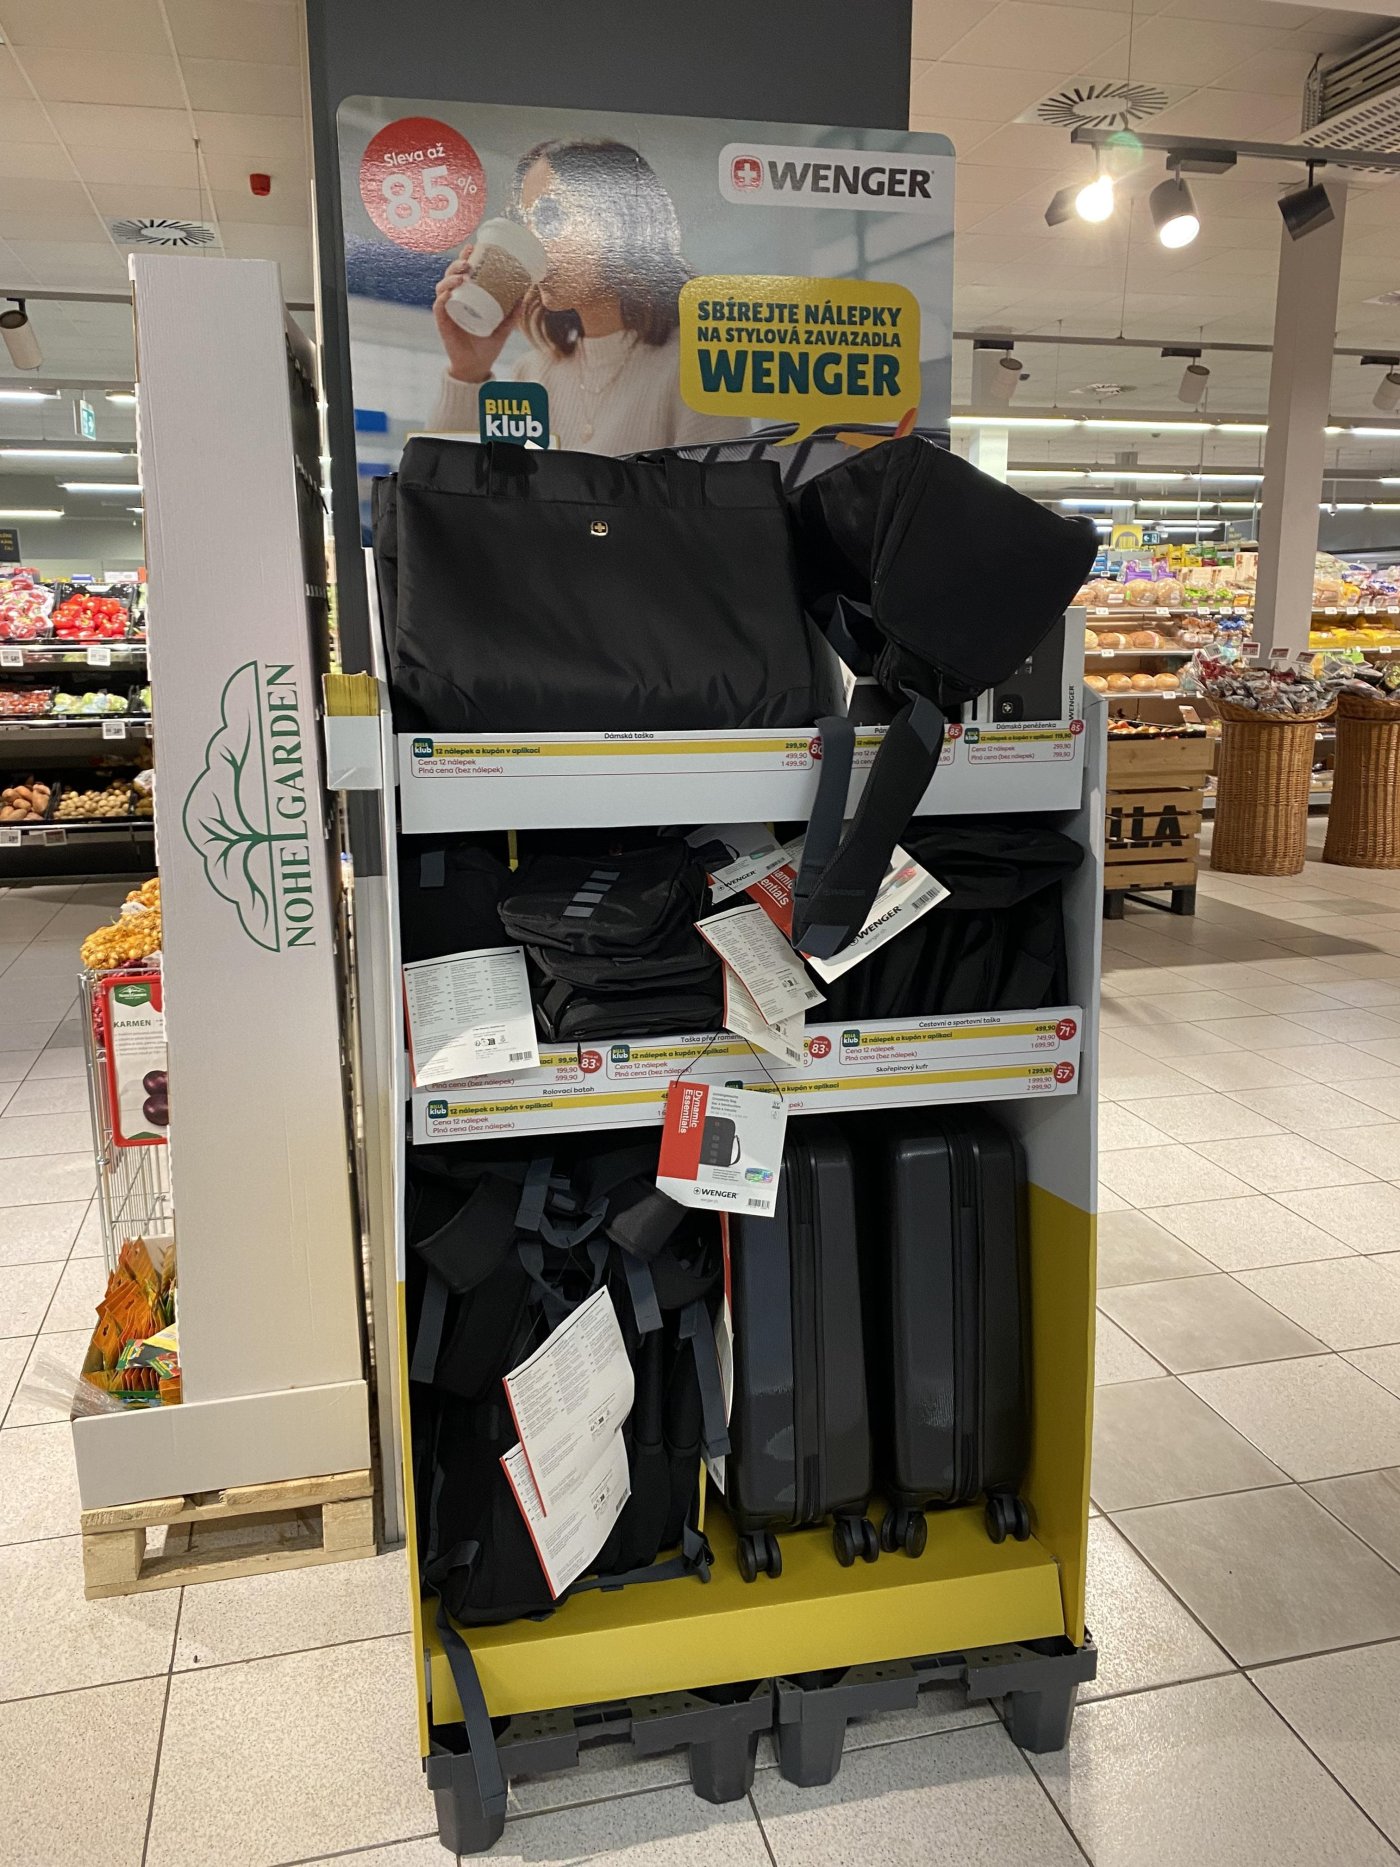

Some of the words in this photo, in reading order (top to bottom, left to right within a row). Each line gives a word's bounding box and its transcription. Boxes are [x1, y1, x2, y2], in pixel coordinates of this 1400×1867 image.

[383, 150, 424, 167] Sleva
[427, 142, 446, 160] až
[768, 160, 932, 199] WENGER
[697, 296, 799, 324] SBÍREJTE
[804, 299, 902, 328] NÁLEPKY
[697, 326, 722, 343] NA
[725, 326, 801, 345] STYLOVÁ
[804, 330, 902, 348] ZAVAZADLA
[697, 348, 902, 397] WENGER
[485, 398, 532, 415] BILLA
[485, 414, 543, 438] klub
[604, 731, 633, 740] Dámská
[634, 731, 655, 739] taška
[414, 746, 432, 754] klub
[785, 741, 808, 750] 299,90
[444, 747, 475, 756] nálepek
[481, 747, 505, 756] kupón
[785, 752, 808, 760] 499,90
[439, 758, 446, 766] 12
[447, 758, 477, 767] nálepek
[454, 766, 471, 775] (bez
[472, 765, 504, 774] nálepek)
[760, 878, 789, 906] entials
[856, 904, 903, 939] WENGER
[113, 1019, 152, 1028] KARMEN
[952, 1018, 982, 1028] sportovní
[843, 1036, 859, 1044] klub
[868, 1036, 895, 1044] nálepek
[901, 1034, 922, 1042] kupón
[870, 1045, 895, 1053] nálepek
[639, 1051, 667, 1060] nálepek
[674, 1049, 696, 1058] kupón
[875, 1053, 890, 1061] (bez
[890, 1051, 918, 1059] nálepek)
[558, 1056, 578, 1064] 99,90
[641, 1061, 668, 1070] nálepek
[875, 1064, 915, 1073] Skořepinový
[647, 1069, 663, 1077] (bez
[467, 1080, 483, 1088] (bez
[484, 1078, 515, 1086] nálepek)
[573, 1086, 595, 1095] batoh
[786, 1085, 808, 1093] kupón
[429, 1107, 447, 1115] klub
[458, 1106, 488, 1115] nálepek
[495, 1104, 518, 1113] kupón
[680, 1088, 694, 1134] Essentials
[691, 1089, 704, 1128] Dynamic
[461, 1116, 489, 1125] nálepek
[468, 1124, 484, 1133] (bez
[484, 1122, 515, 1131] nálepek)
[701, 1188, 737, 1199] WENGER
